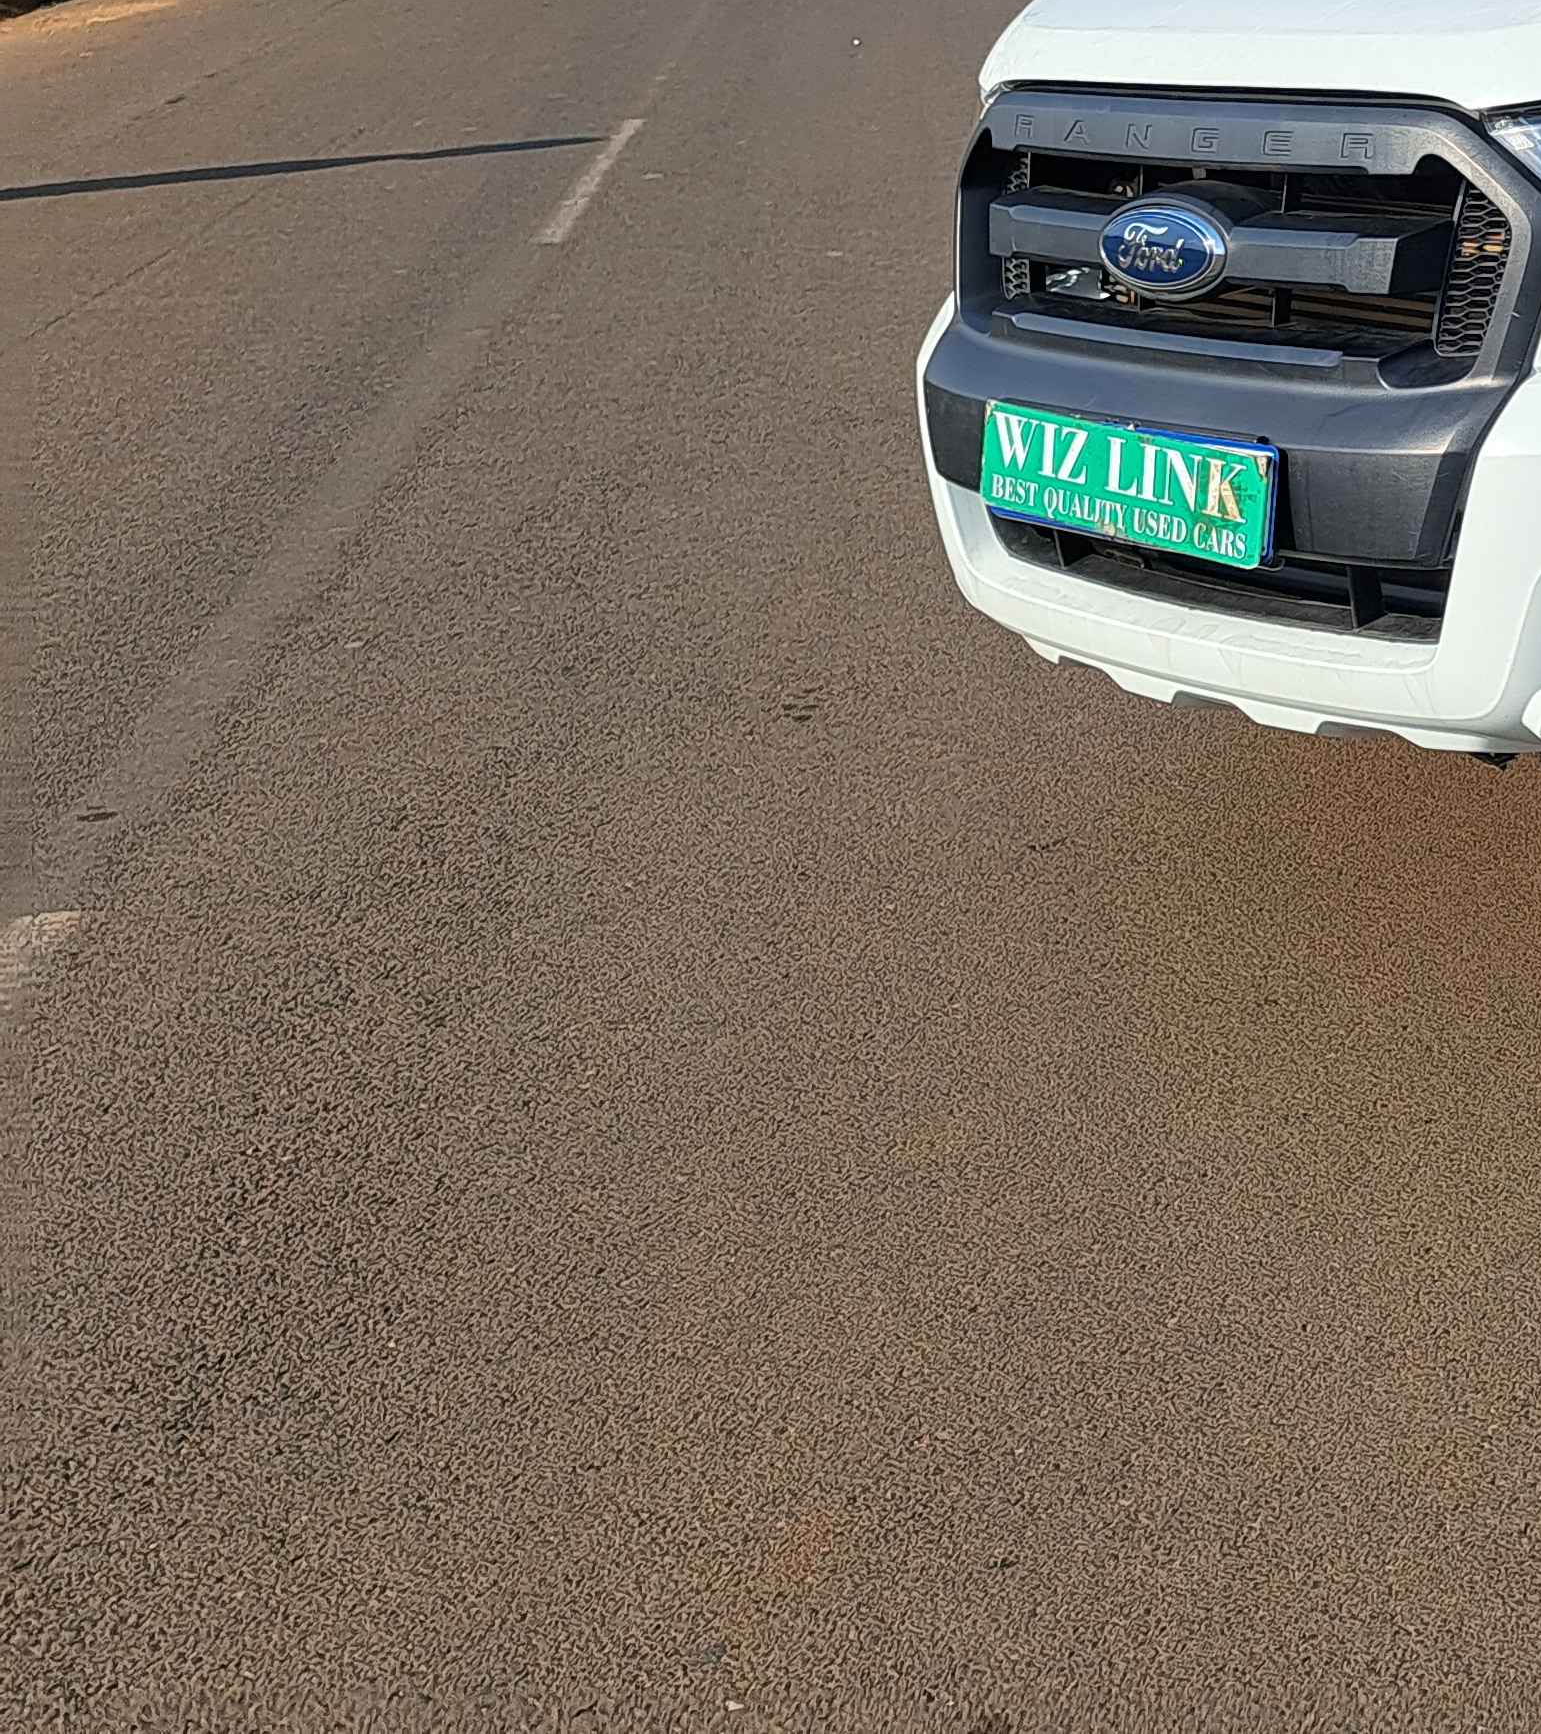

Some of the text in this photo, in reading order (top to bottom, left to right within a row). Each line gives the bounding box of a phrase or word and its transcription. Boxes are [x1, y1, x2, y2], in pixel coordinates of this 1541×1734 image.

[1014, 114, 1374, 159] RANGER
[1117, 222, 1185, 274] Ford
[993, 411, 1247, 524] WIZ LINK
[992, 474, 1248, 560] BEST QUALITY USED CARS
